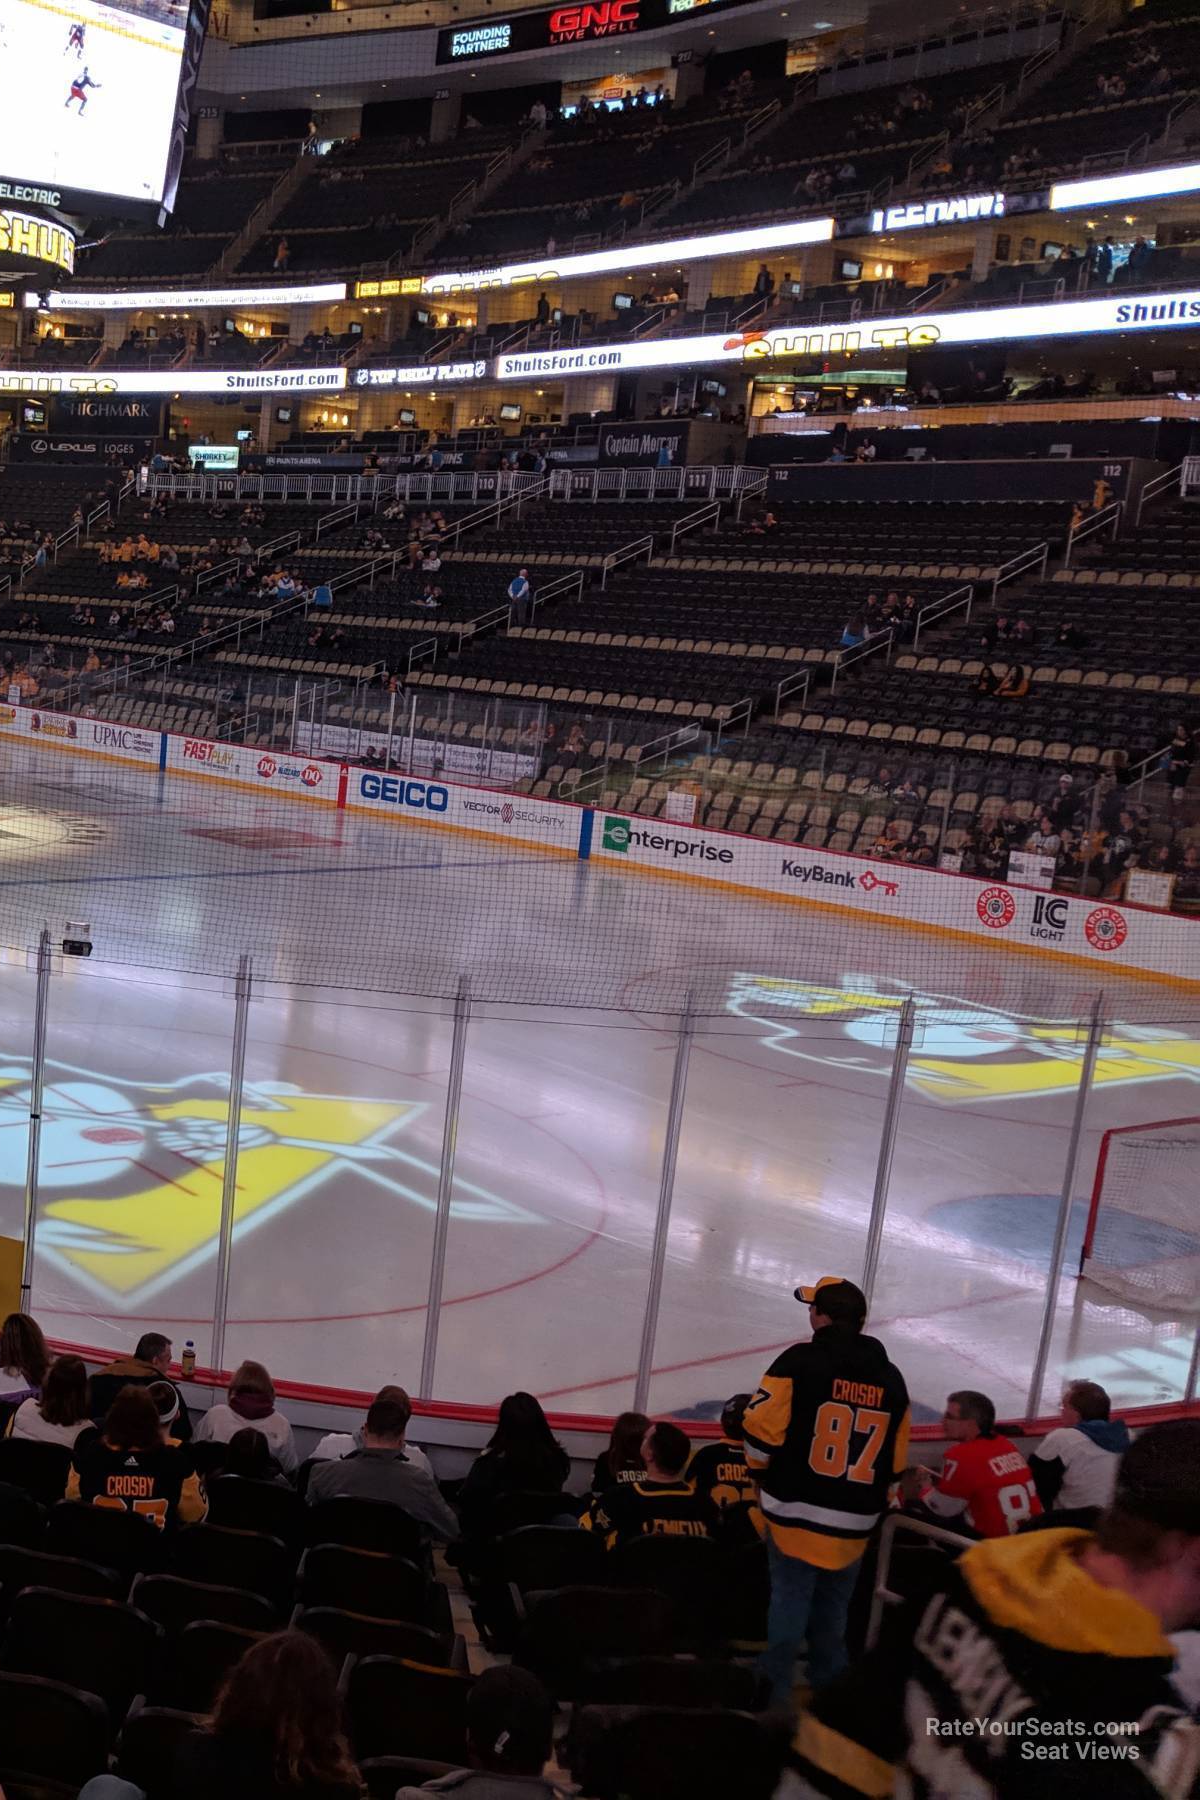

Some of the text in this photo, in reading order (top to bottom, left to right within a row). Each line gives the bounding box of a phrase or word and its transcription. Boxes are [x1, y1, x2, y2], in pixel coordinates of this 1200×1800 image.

[550, 0, 640, 32] GNC
[453, 25, 511, 45] FOUNDING
[550, 20, 638, 43] LIVE WELL
[452, 37, 509, 56] PARTNERS
[200, 108, 218, 118] 215
[0, 183, 61, 206] ELECTRIC
[505, 351, 622, 374] ShultsFord.com
[226, 372, 339, 389] ShultsFord.com
[370, 369, 396, 383] TOP
[71, 402, 150, 417] HIGHMARK
[48, 442, 134, 454] LEXUS LOGES
[605, 434, 639, 457] Captain
[194, 452, 227, 462] SHORKEY
[276, 457, 298, 465] PAINTS
[299, 457, 322, 465] ARENA
[689, 475, 707, 487] 111
[775, 470, 788, 481] 112
[1103, 465, 1121, 477] 112
[218, 480, 234, 491] 110
[479, 478, 495, 489] 110
[574, 476, 590, 488] 111
[93, 724, 132, 749] UPMC
[183, 740, 215, 761] FAST
[360, 774, 449, 812] GEICO
[463, 800, 565, 829] VECTOR SECURITY
[605, 826, 734, 864] enterprise
[782, 859, 856, 888] KeyBank
[979, 888, 999, 908] IRON
[982, 912, 1007, 927] BEER
[1032, 895, 1068, 929] IC
[1030, 925, 1065, 942] LIGHT
[1092, 937, 1118, 949] BEER
[832, 1378, 885, 1408] CROSBY
[808, 1401, 890, 1485] 87
[106, 1474, 155, 1498] CROSBY
[998, 1483, 1041, 1534] 8
